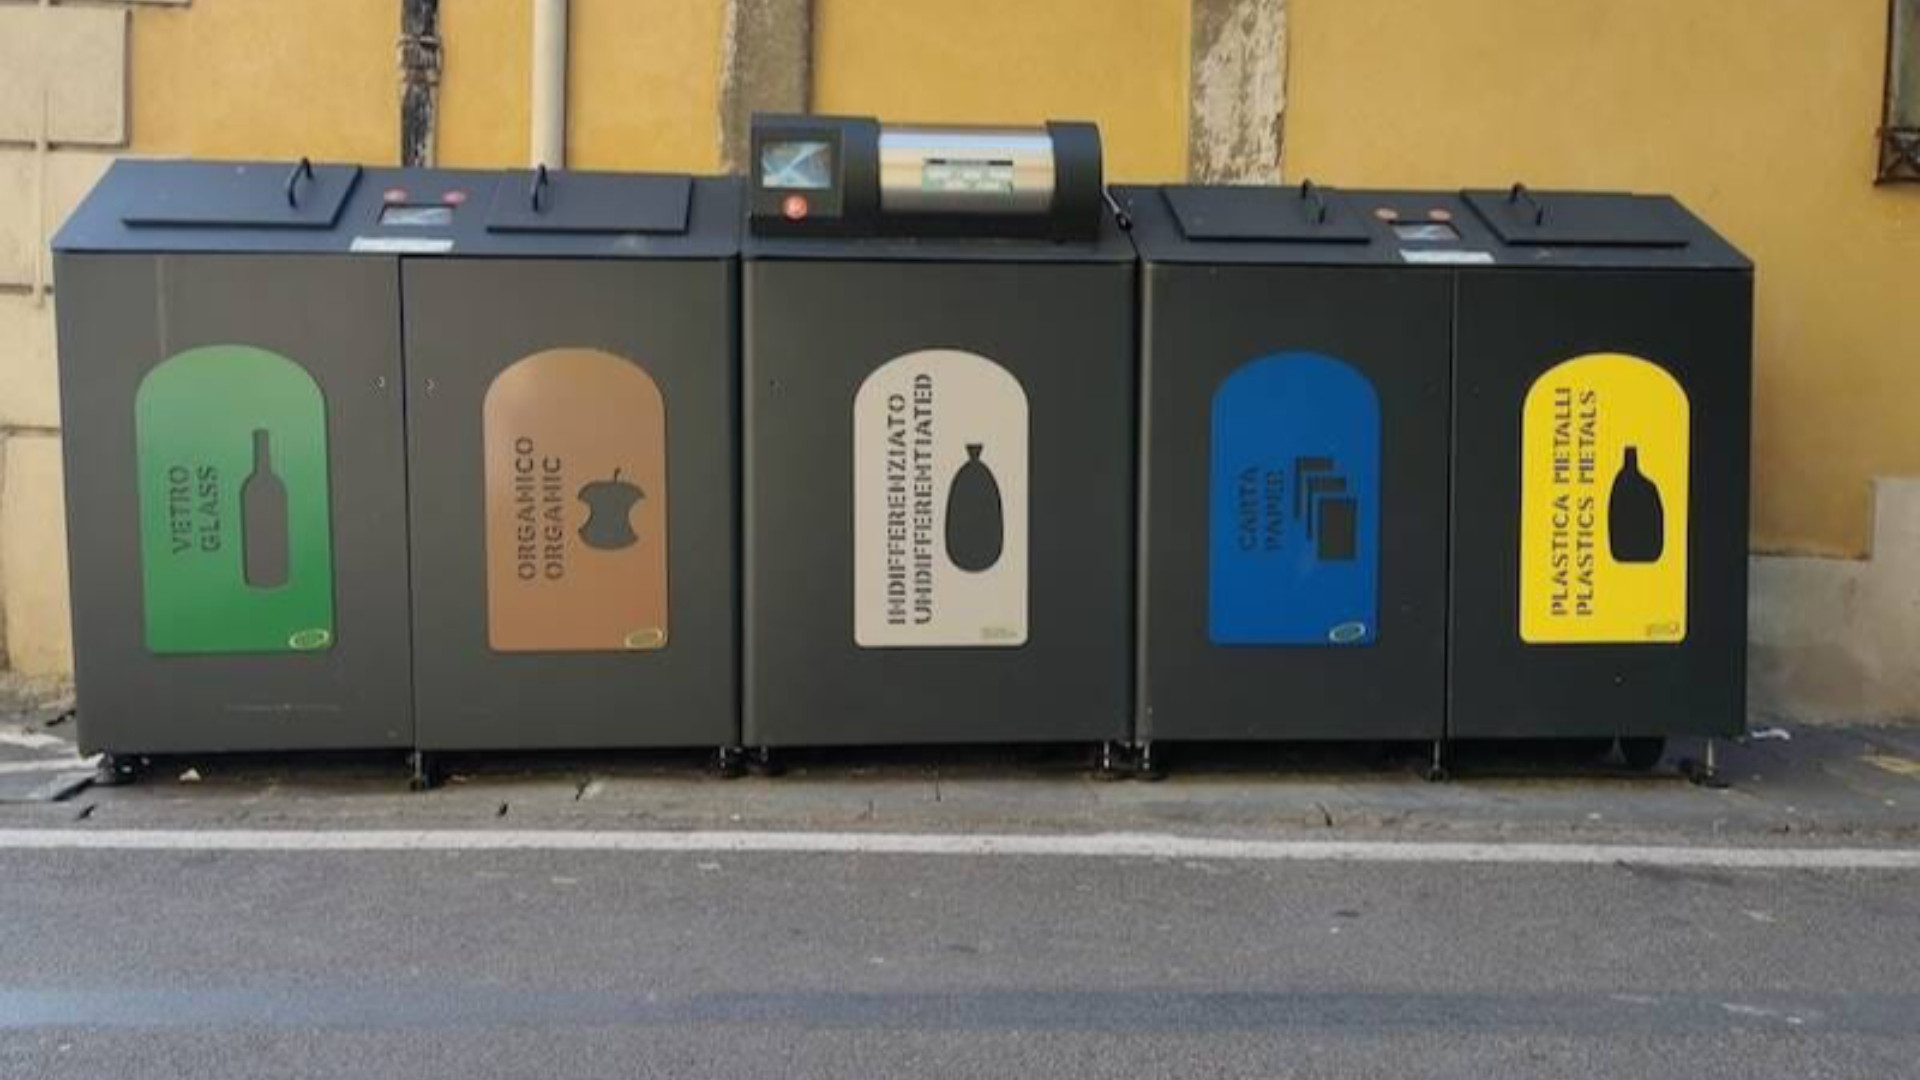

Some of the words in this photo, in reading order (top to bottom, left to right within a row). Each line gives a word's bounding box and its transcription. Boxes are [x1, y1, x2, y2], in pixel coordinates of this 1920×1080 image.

[1554, 387, 1572, 483] METALLI
[1578, 390, 1597, 484] METALS
[169, 464, 192, 555] VETRO
[198, 464, 220, 552] GLASS
[515, 436, 536, 580] ORGANICO
[542, 455, 564, 580] ORGANIC
[888, 393, 906, 625] INDIFFERENZIATO
[914, 374, 933, 625] UNDIFFERENTIATED
[1239, 466, 1259, 551] CARTA
[1552, 494, 1570, 616] PLASTICA
[1576, 497, 1595, 616] PLASTICS
